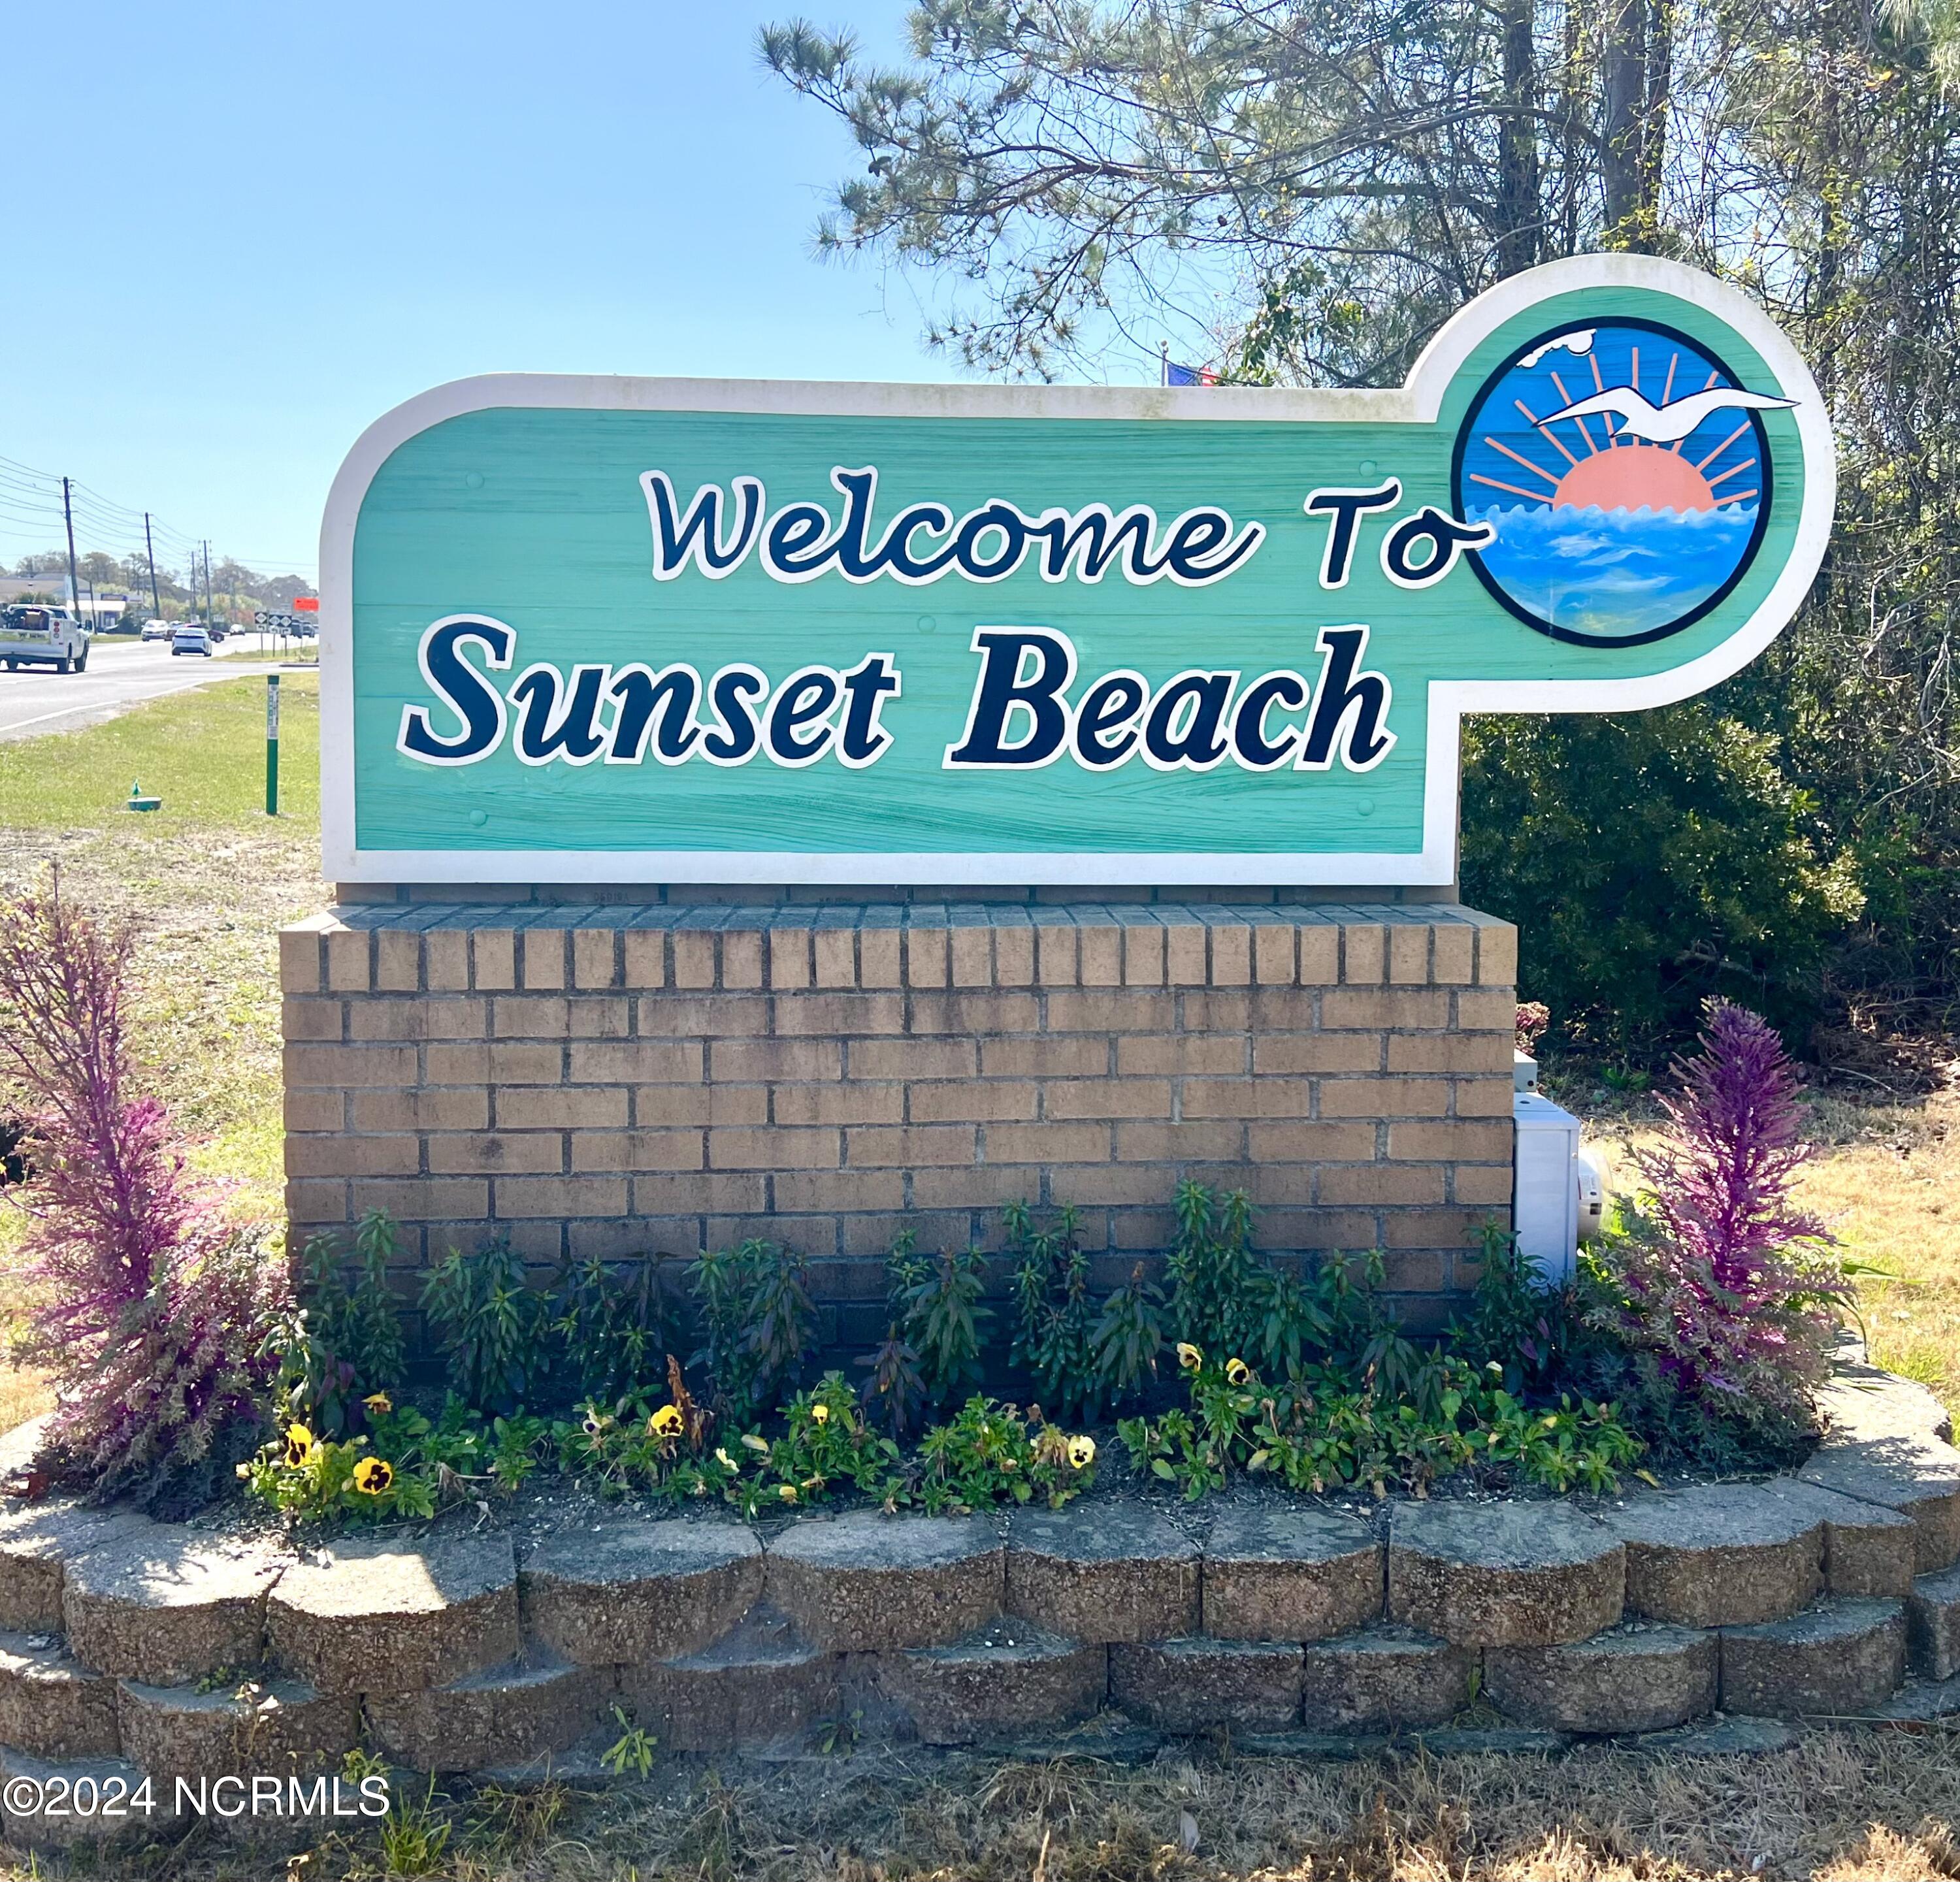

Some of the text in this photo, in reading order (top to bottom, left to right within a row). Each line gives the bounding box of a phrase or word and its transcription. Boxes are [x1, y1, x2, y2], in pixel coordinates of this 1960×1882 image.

[647, 472, 1492, 584] Welcome To
[401, 619, 898, 762] Sunset
[948, 628, 1390, 767] Beach
